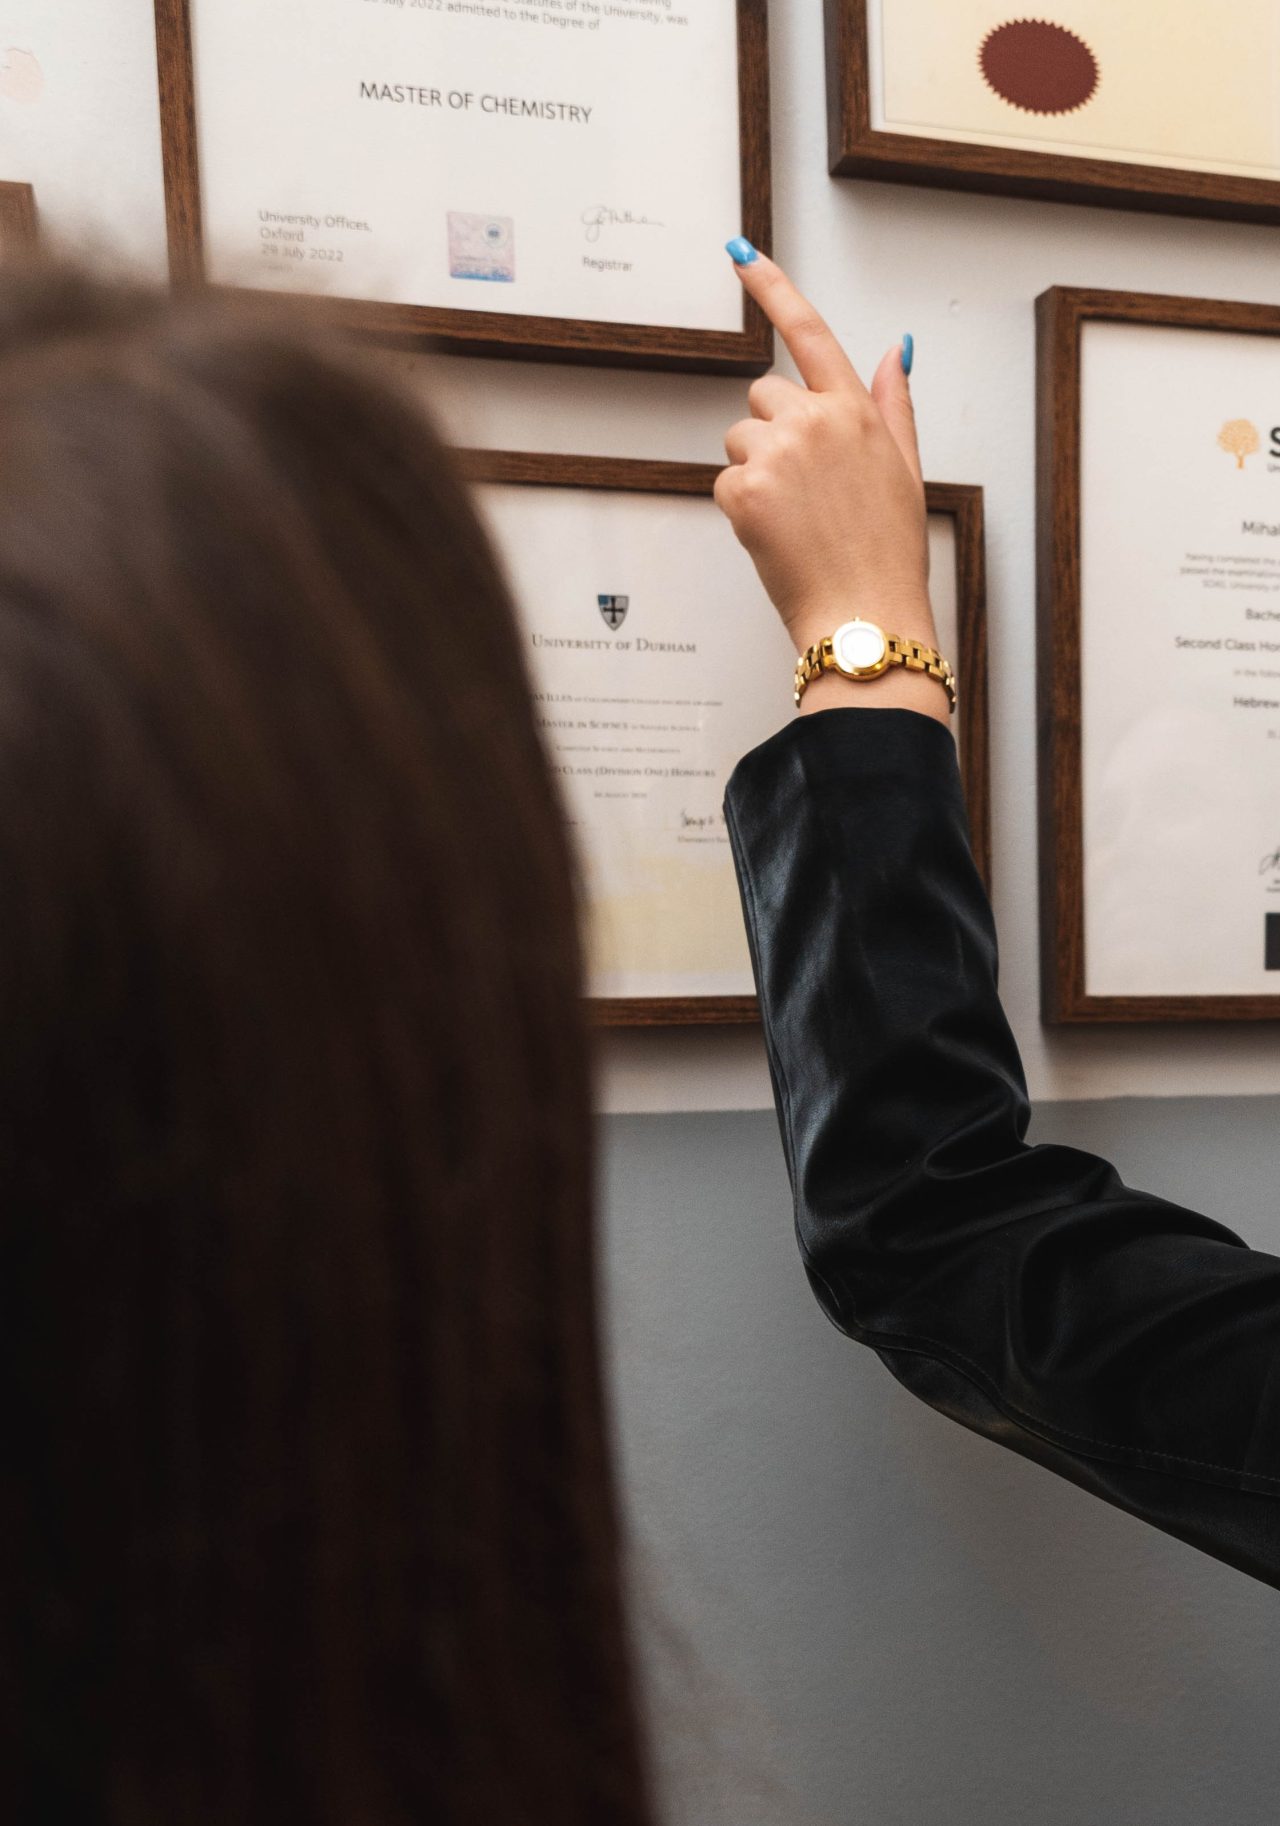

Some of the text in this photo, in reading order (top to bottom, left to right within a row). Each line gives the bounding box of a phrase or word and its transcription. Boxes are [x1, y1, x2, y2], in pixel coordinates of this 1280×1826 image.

[447, 2, 500, 18] admitted
[504, 9, 517, 20] to
[519, 9, 539, 23] the
[543, 12, 585, 29] Degree
[360, 81, 593, 124] MASTER OF CHEMISTRY
[258, 209, 320, 230] University
[260, 226, 304, 242] Oxford
[283, 246, 305, 261] July
[310, 247, 344, 262] 2022
[582, 255, 633, 272] Registrar
[635, 637, 697, 653] DURHAM
[1175, 636, 1222, 650] Second
[1224, 638, 1256, 652] Class
[1233, 697, 1280, 709] Hebrew
